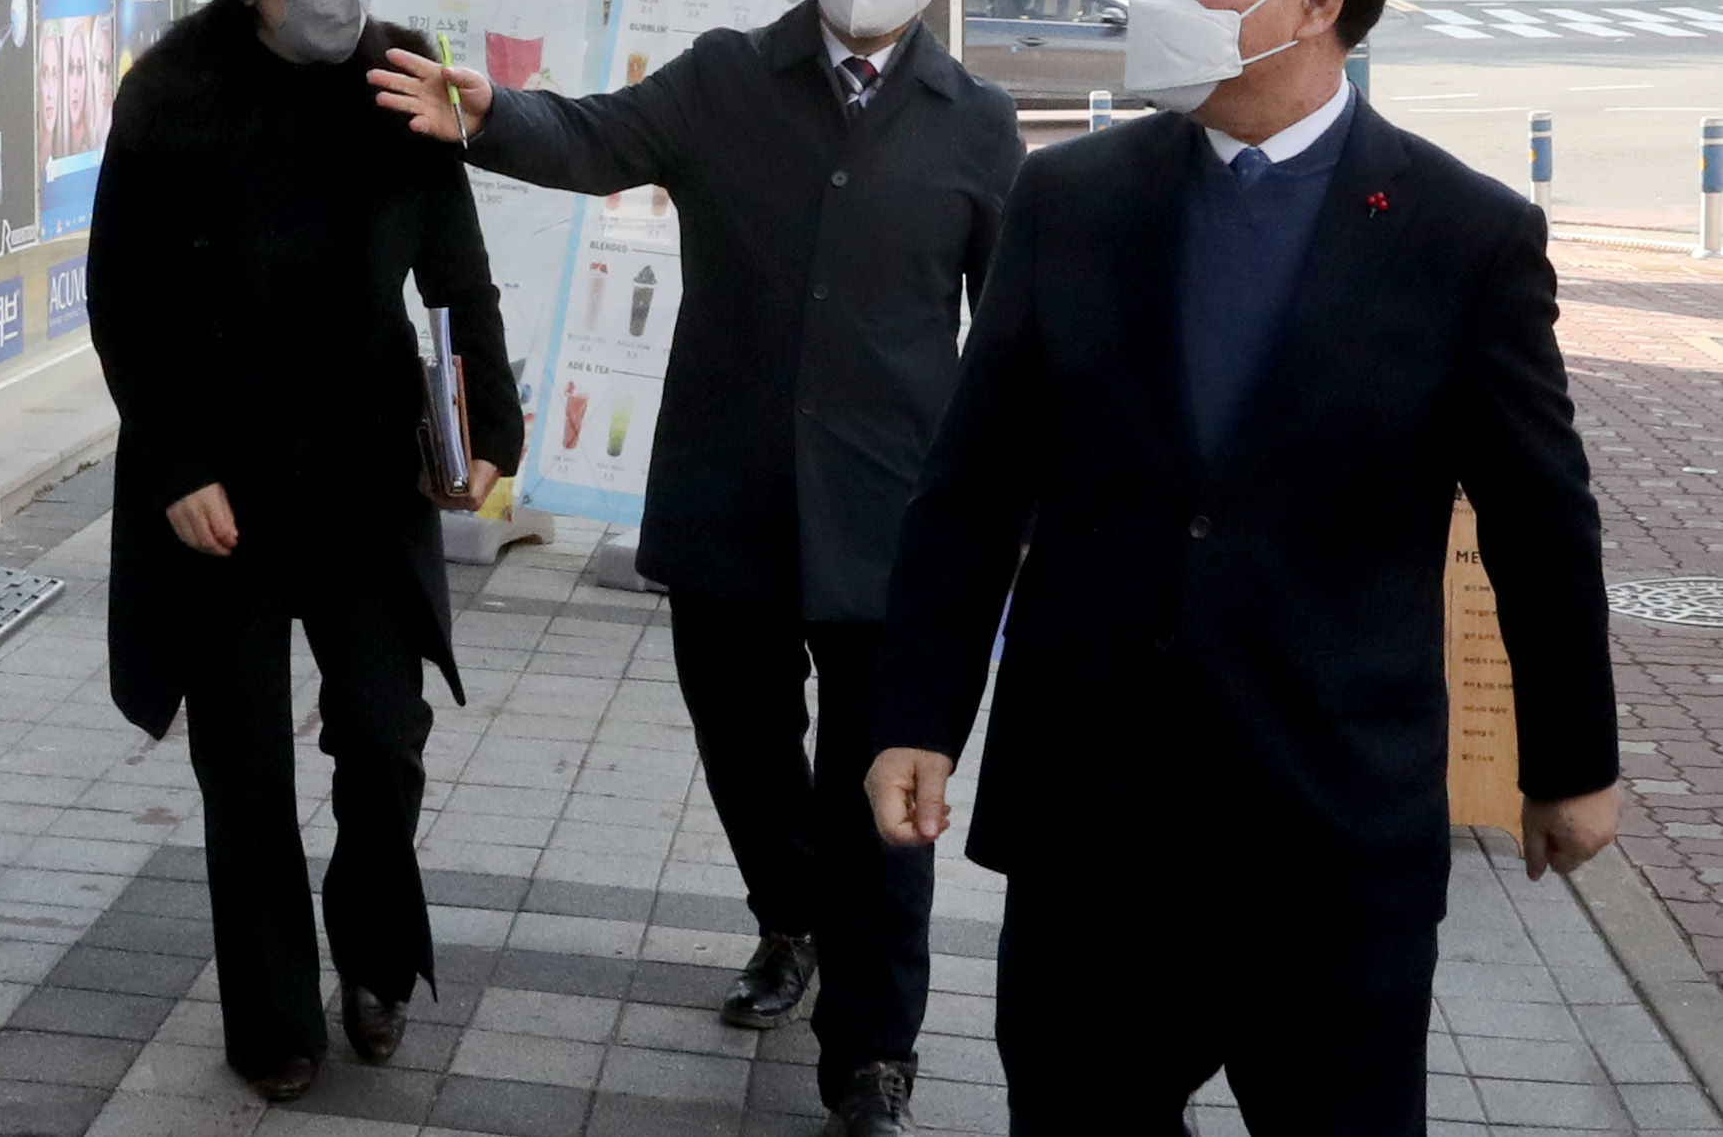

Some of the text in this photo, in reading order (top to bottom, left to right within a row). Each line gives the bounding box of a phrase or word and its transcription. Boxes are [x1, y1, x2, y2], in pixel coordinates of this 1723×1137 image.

[590, 241, 628, 254] BLENDED
[568, 360, 582, 371] ADE
[595, 365, 610, 374] TEA
[1456, 550, 1481, 565] ME
